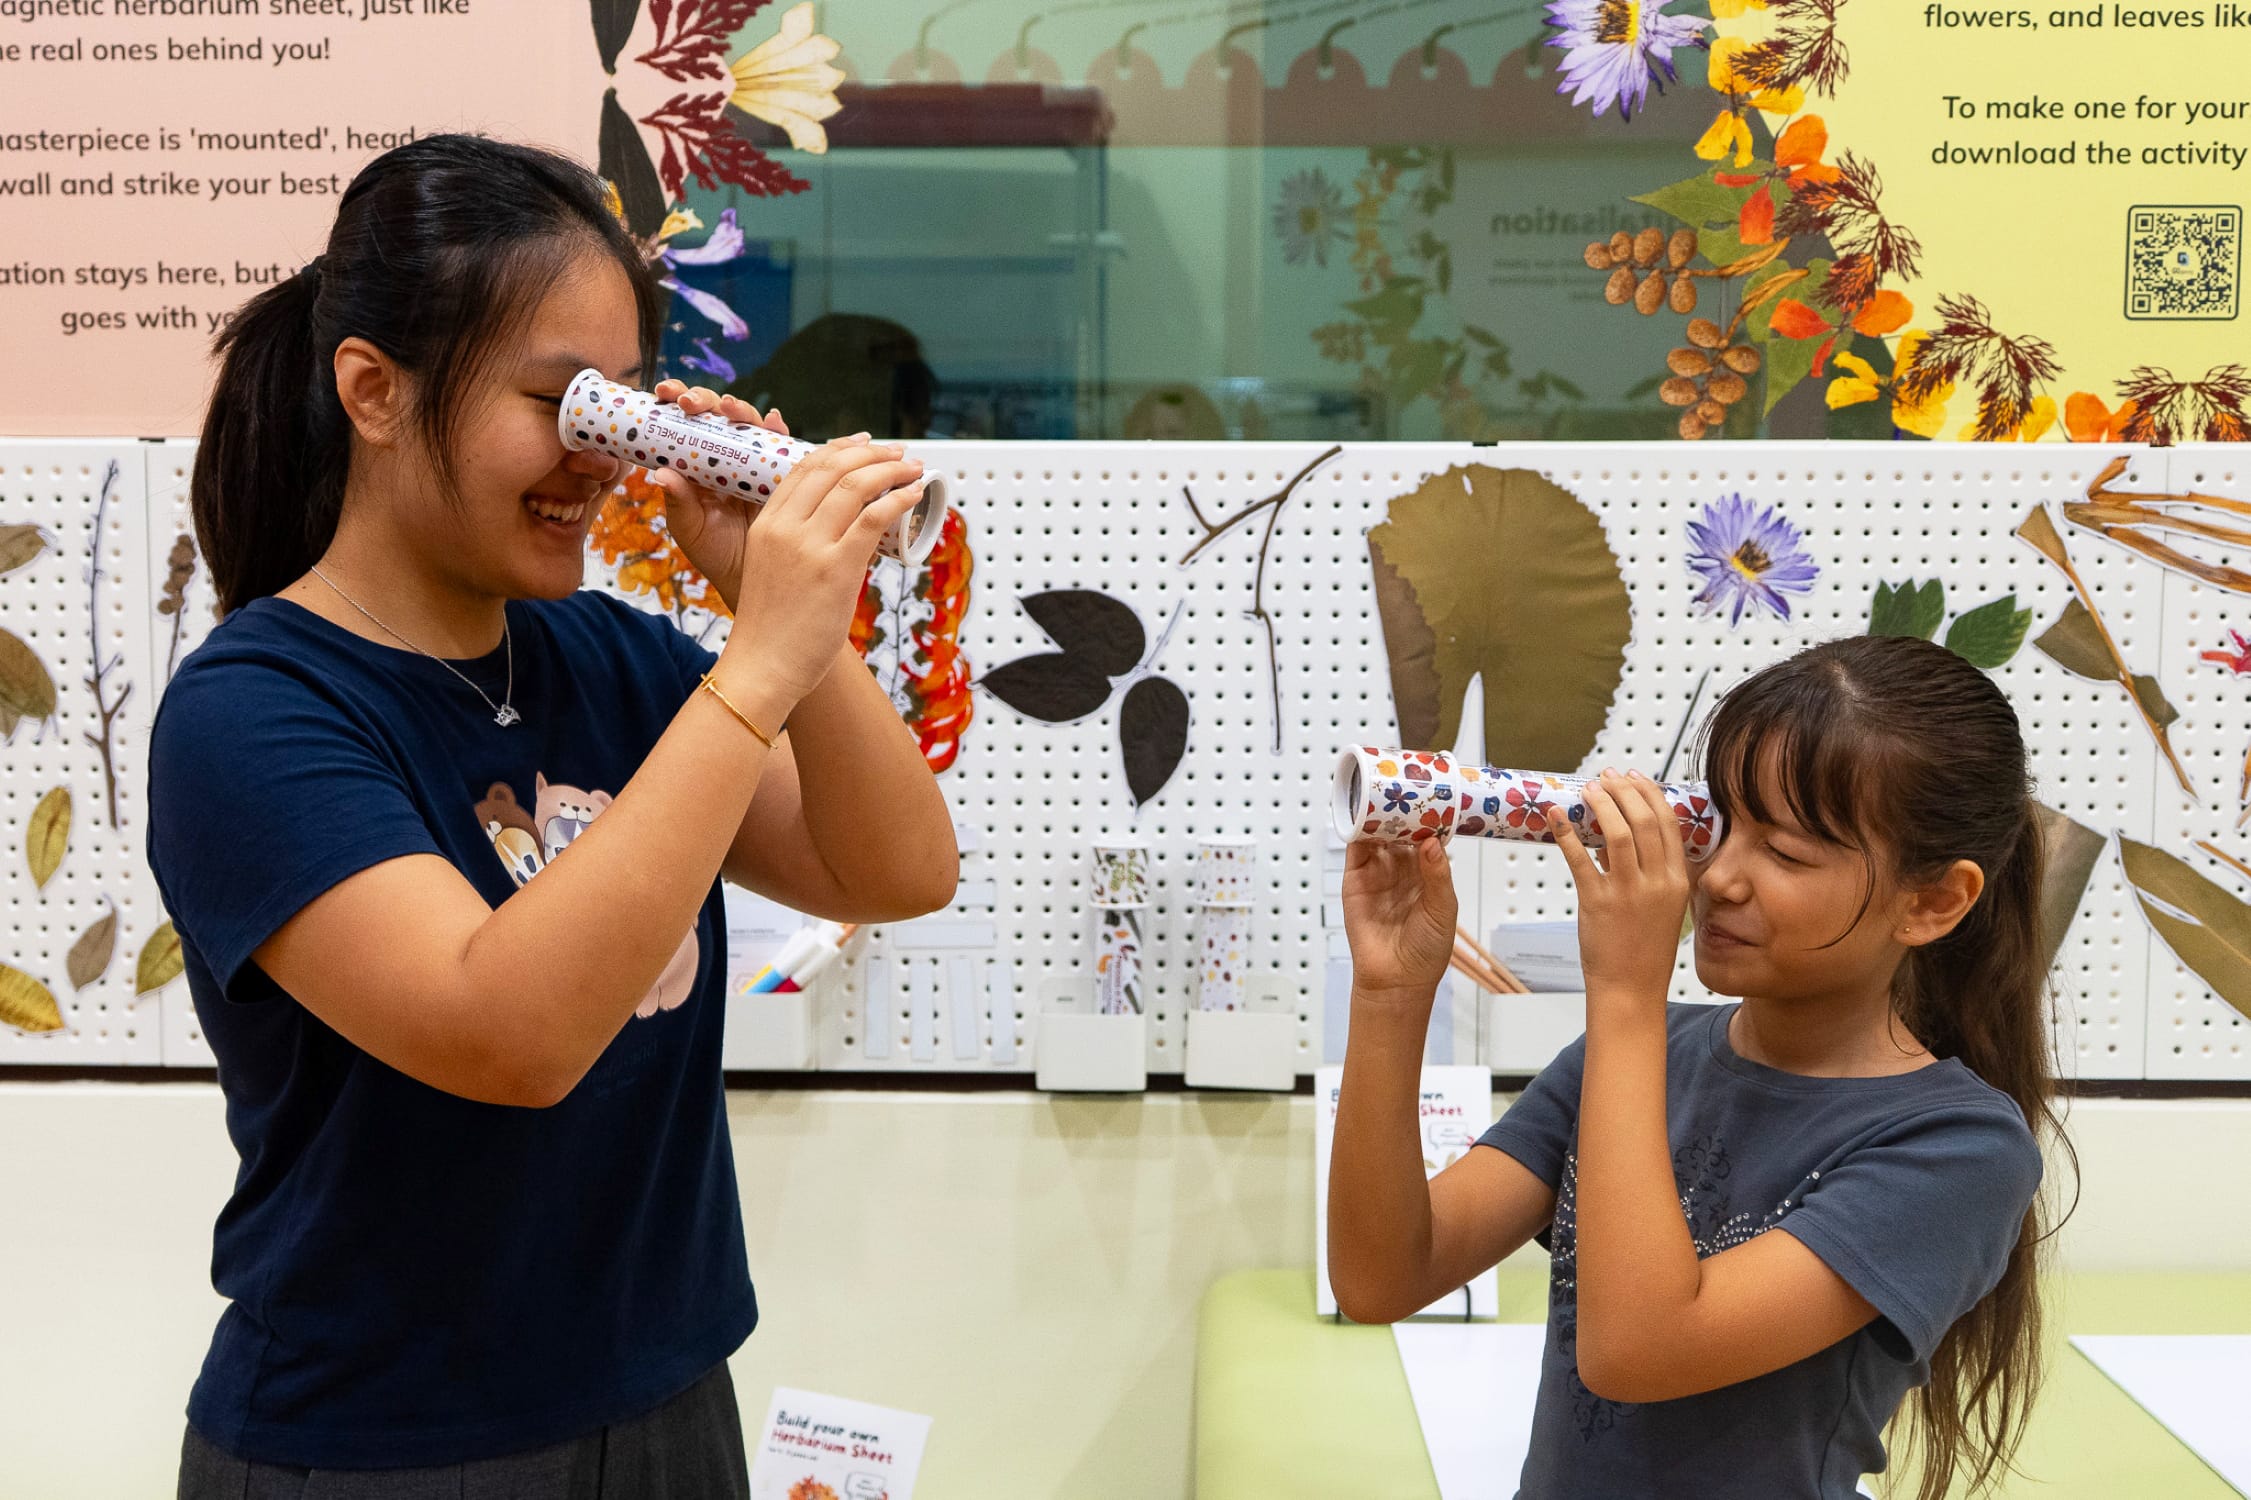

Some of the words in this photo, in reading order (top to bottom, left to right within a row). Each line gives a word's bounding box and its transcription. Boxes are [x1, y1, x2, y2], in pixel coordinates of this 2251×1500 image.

[1, 0, 104, 23] agnetic
[114, 0, 260, 16] herbarium
[269, 0, 353, 18] sheet,
[360, 0, 414, 21] just
[423, 0, 470, 15] like
[1923, 3, 2038, 31] flowers,
[2048, 3, 2104, 28] and
[2113, 3, 2205, 28] leaves
[2214, 3, 2251, 28] lik
[30, 36, 83, 62] real
[92, 43, 158, 62] ones
[167, 36, 263, 61] behind
[271, 36, 330, 67] you!
[1941, 95, 1976, 120] To
[1986, 94, 2065, 120] make
[2073, 101, 2127, 120] one
[2134, 94, 2177, 120] for
[2184, 101, 2251, 126] your
[159, 127, 181, 151] is
[190, 126, 337, 153] 'mounted',
[346, 125, 416, 150] head
[1931, 140, 2076, 165] download
[2084, 140, 2132, 165] the
[2141, 140, 2249, 172] activity
[0, 171, 51, 196] wall
[60, 171, 114, 196] and
[123, 171, 200, 196] strike
[208, 177, 272, 202] your
[280, 171, 340, 196] best
[0, 261, 65, 285] ation
[74, 263, 148, 291] stays
[157, 260, 225, 287] here,
[234, 261, 280, 284] but
[60, 311, 127, 337] goes
[135, 305, 198, 329] with
[206, 311, 236, 334] yo
[647, 424, 687, 445] PIXELS
[776, 1410, 811, 1430] Build
[812, 1422, 846, 1437] your
[849, 1430, 880, 1444] own
[771, 1428, 846, 1454] Herbarium
[850, 1444, 893, 1465] Sheet
